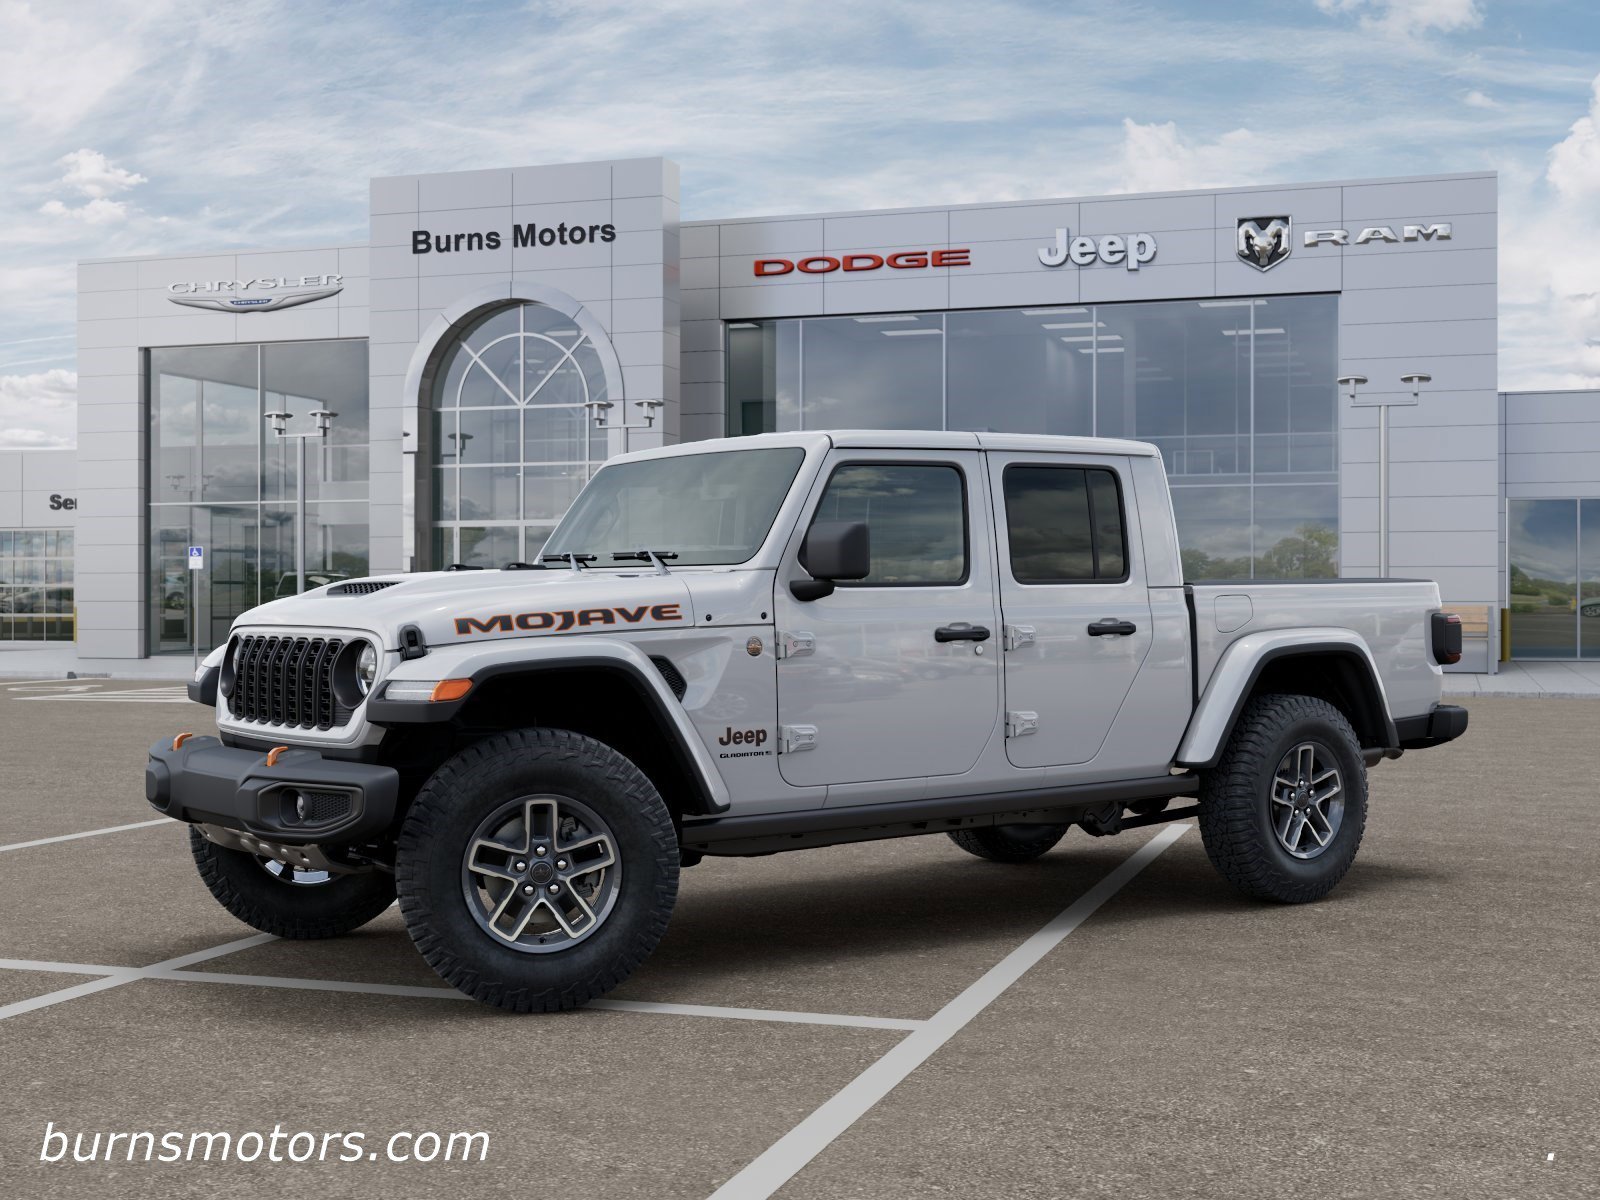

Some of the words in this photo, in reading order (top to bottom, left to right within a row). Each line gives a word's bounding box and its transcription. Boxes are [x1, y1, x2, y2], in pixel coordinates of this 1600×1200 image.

[412, 230, 501, 254] Burns
[513, 222, 617, 248] Motors
[1304, 223, 1452, 248] RAM
[1038, 227, 1157, 272] Jeep
[754, 249, 971, 277] DODGE
[168, 273, 343, 293] CHRYSLER
[49, 494, 78, 511] Se
[454, 603, 683, 635] MOJAVE
[718, 726, 767, 747] Jeep
[719, 751, 765, 759] GLADIATOR
